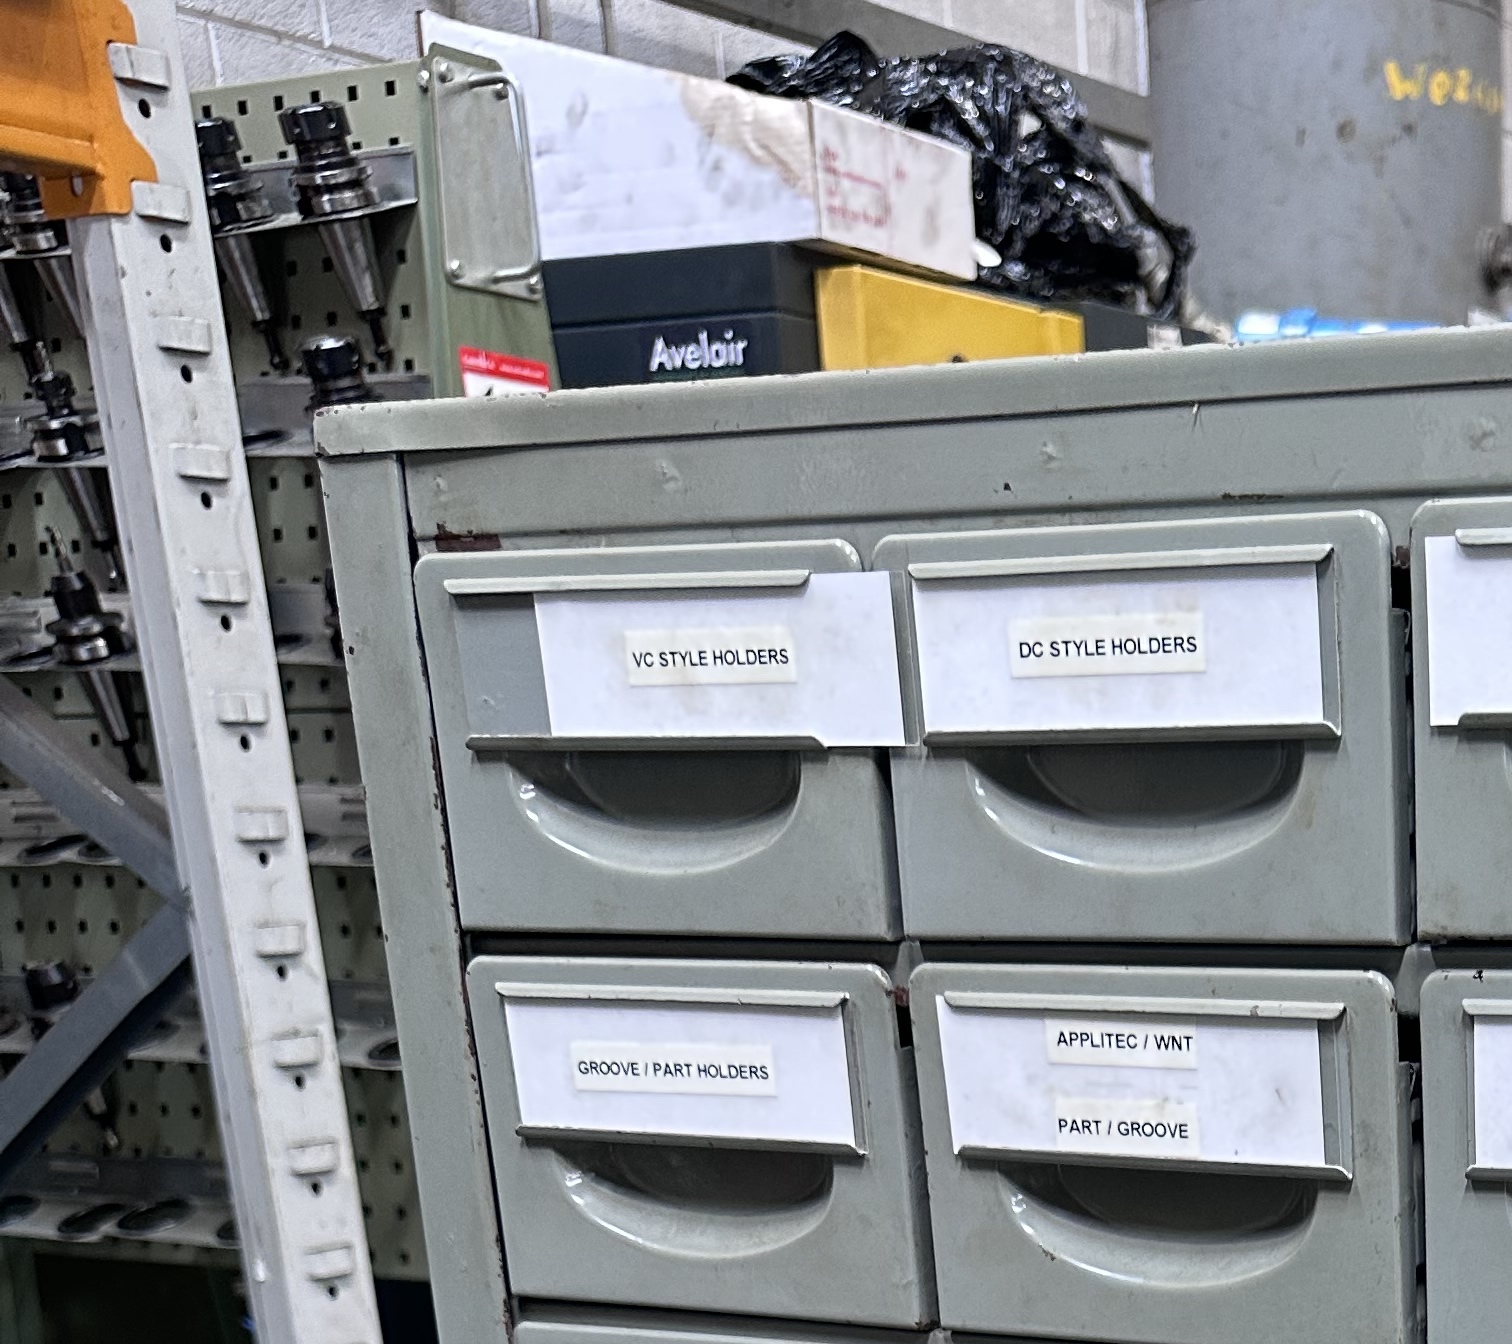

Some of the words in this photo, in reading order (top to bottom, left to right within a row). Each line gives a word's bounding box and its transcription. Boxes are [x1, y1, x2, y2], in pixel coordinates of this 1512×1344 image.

[649, 328, 748, 373] Avelair
[632, 652, 654, 668] VC
[658, 650, 709, 668] STYLE
[712, 648, 789, 666] HOLDERS
[1019, 641, 1044, 659] DC
[1049, 639, 1106, 658] STYLE
[1111, 636, 1198, 656] HOLDERS
[1057, 1031, 1138, 1050] APPLITEC
[1153, 1034, 1194, 1052] WNT
[577, 1060, 640, 1077] GROOVE
[652, 1062, 693, 1078] PART
[696, 1063, 769, 1080] HOLDERS
[1058, 1118, 1102, 1135] PART
[1117, 1121, 1189, 1139] GROOVE
